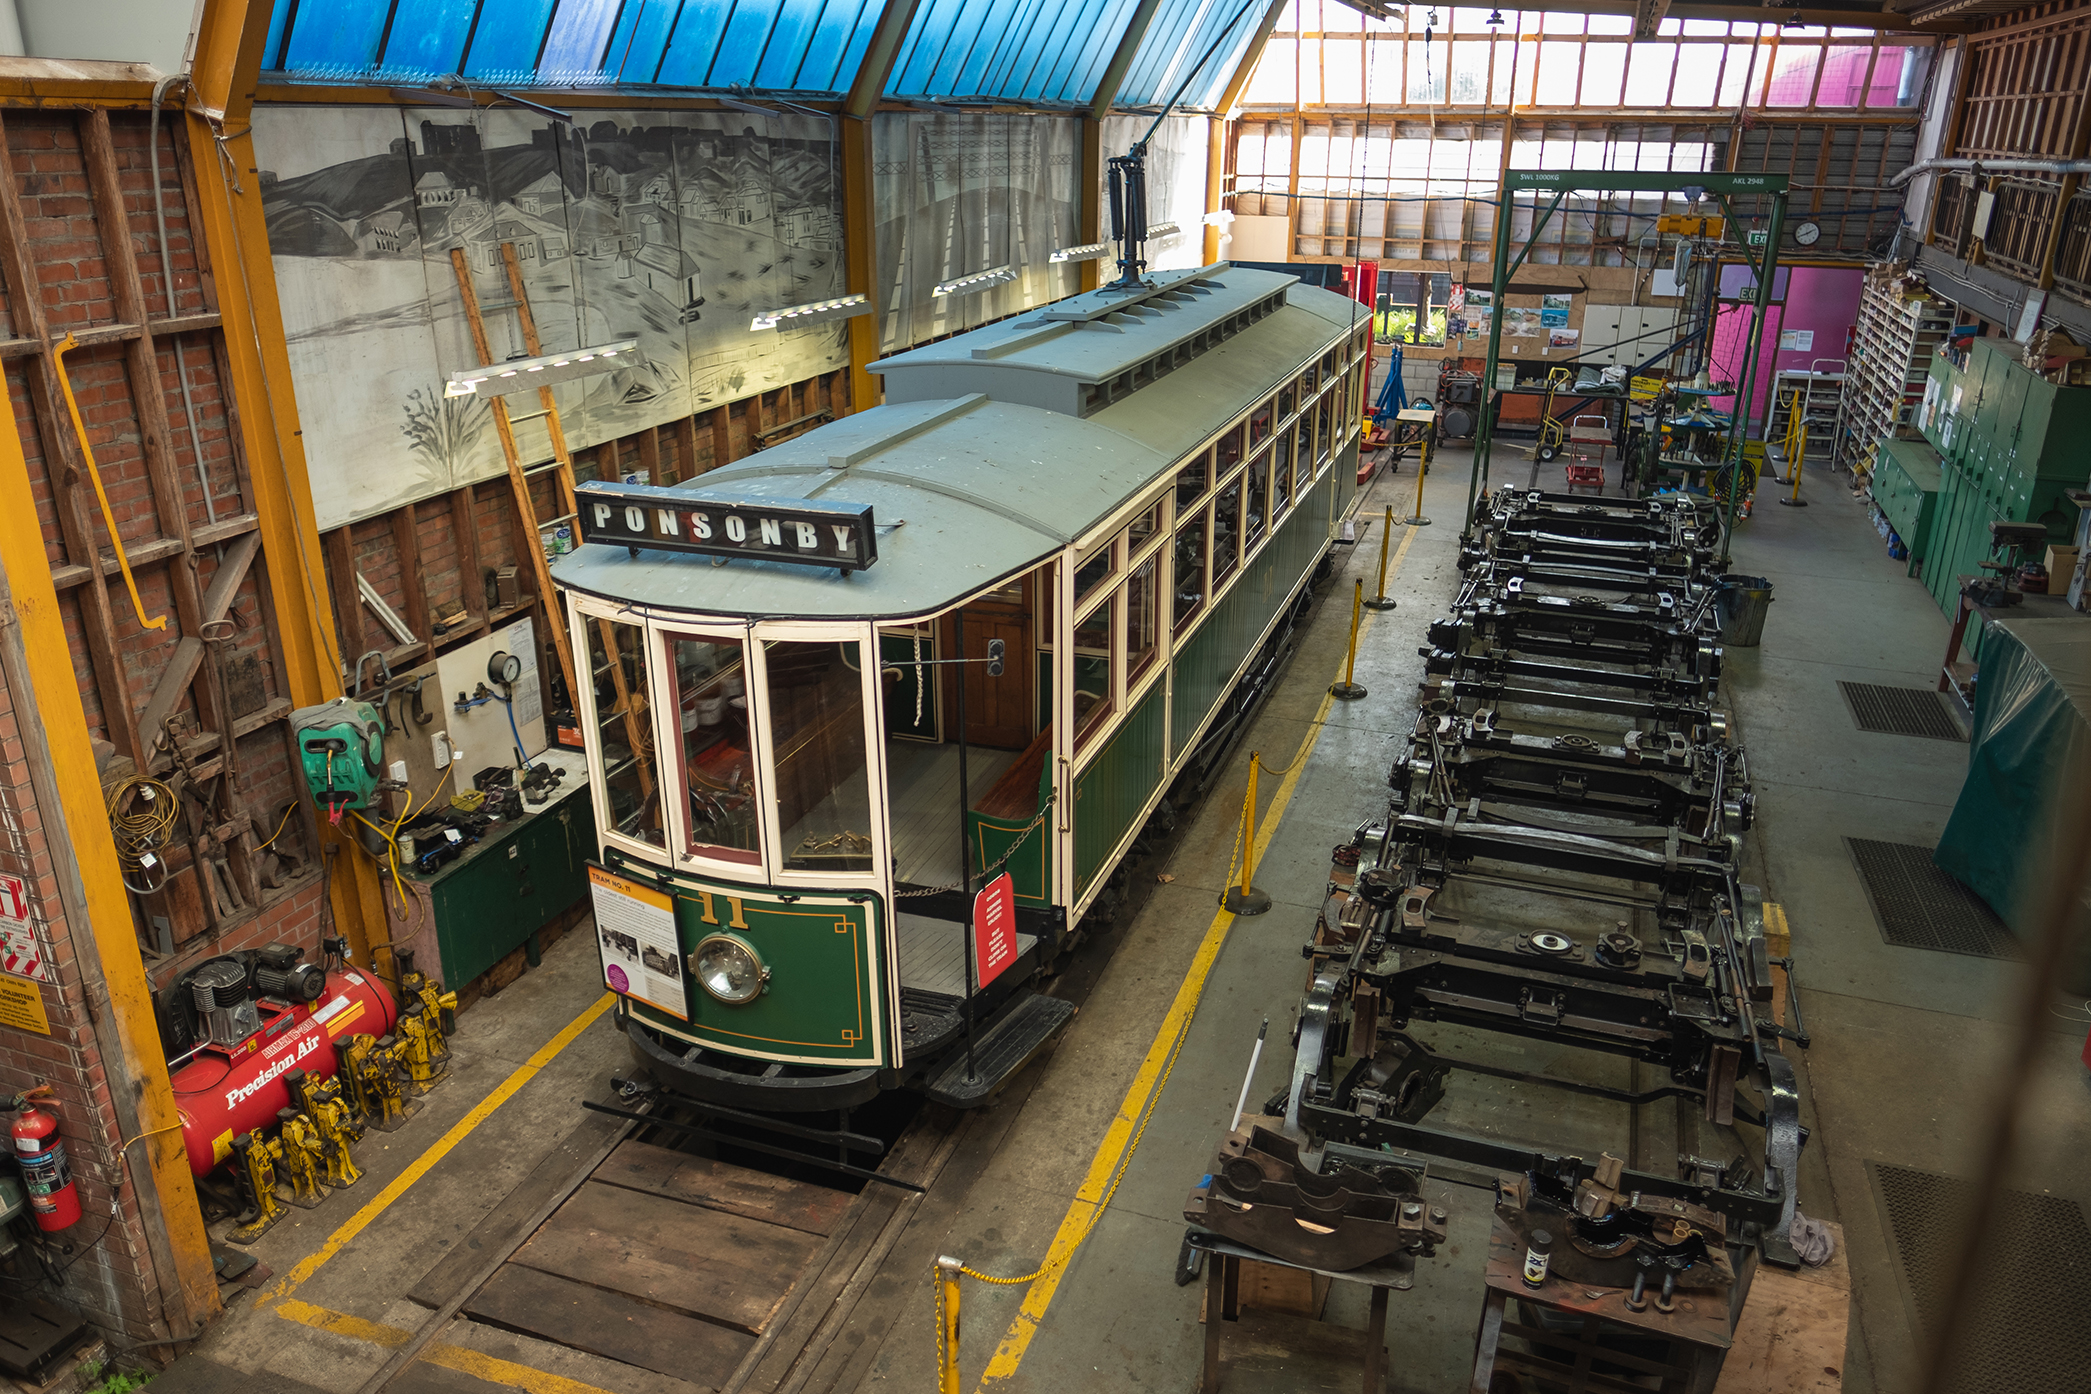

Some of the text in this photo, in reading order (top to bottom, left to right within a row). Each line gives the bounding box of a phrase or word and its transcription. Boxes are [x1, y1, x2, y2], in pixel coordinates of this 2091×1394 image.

[1535, 173, 1560, 181] 1000KG
[1732, 177, 1764, 185] AKL 2948
[1754, 234, 1767, 244] EXI
[1741, 288, 1757, 299] EXI
[593, 502, 850, 552] PONSONBY
[592, 872, 631, 893] TRAM NO. 11
[627, 898, 645, 910] running
[698, 891, 749, 930] 11
[988, 931, 1004, 947] PLEASE
[996, 949, 1008, 961] TRAM
[0, 994, 27, 1005] ORKSHOP
[1, 989, 36, 1002] VOLUNTEER
[261, 1034, 294, 1060] AIRMAX
[225, 1035, 320, 1111] Precision Air
